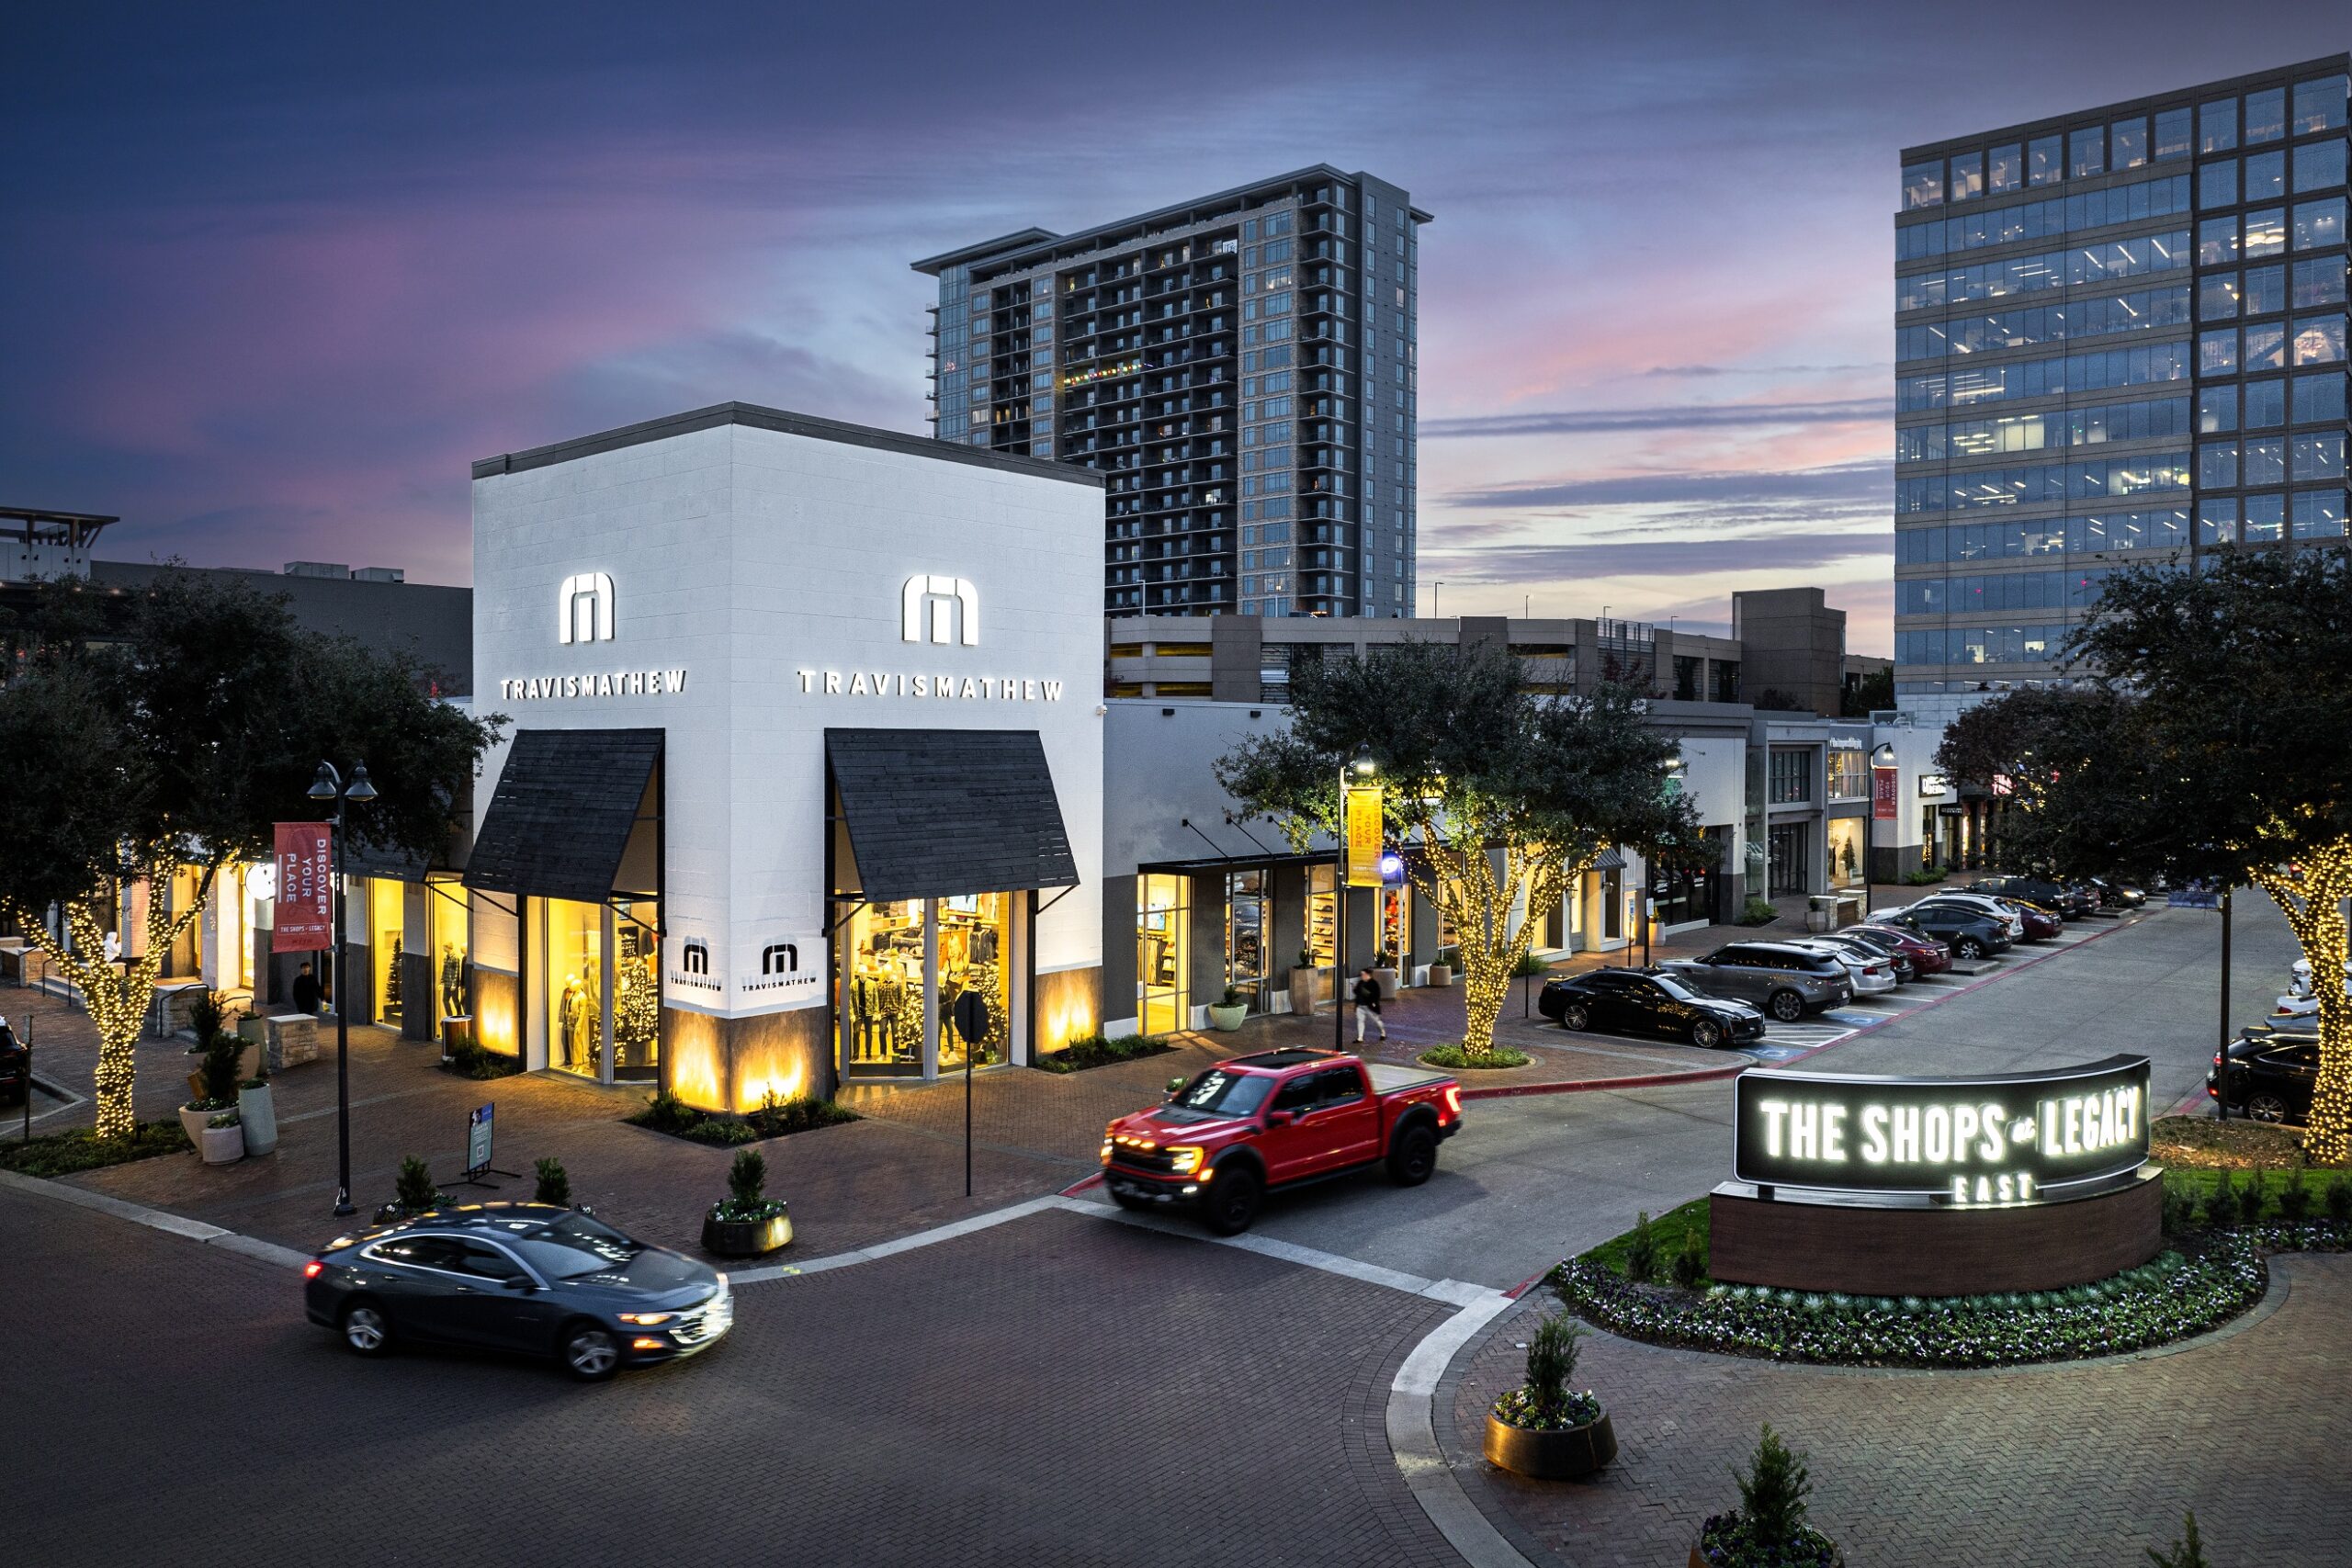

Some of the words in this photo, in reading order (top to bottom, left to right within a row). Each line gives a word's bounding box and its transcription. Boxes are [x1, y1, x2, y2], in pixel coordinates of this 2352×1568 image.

[500, 670, 687, 700] TRAVISMATHEW
[797, 669, 1063, 701] TRAVISMATHEW
[287, 853, 297, 903] PLACE
[301, 857, 312, 897] YOUR
[317, 839, 327, 915] DISCOVER
[671, 977, 721, 992] TRAVISMATHEW
[742, 976, 817, 992] TRAVISMATHEW
[1761, 1101, 1845, 1161] THE
[1861, 1104, 2006, 1163] SHOPS
[2041, 1087, 2142, 1156] LEGACY
[1955, 1175, 2032, 1203] EAST
